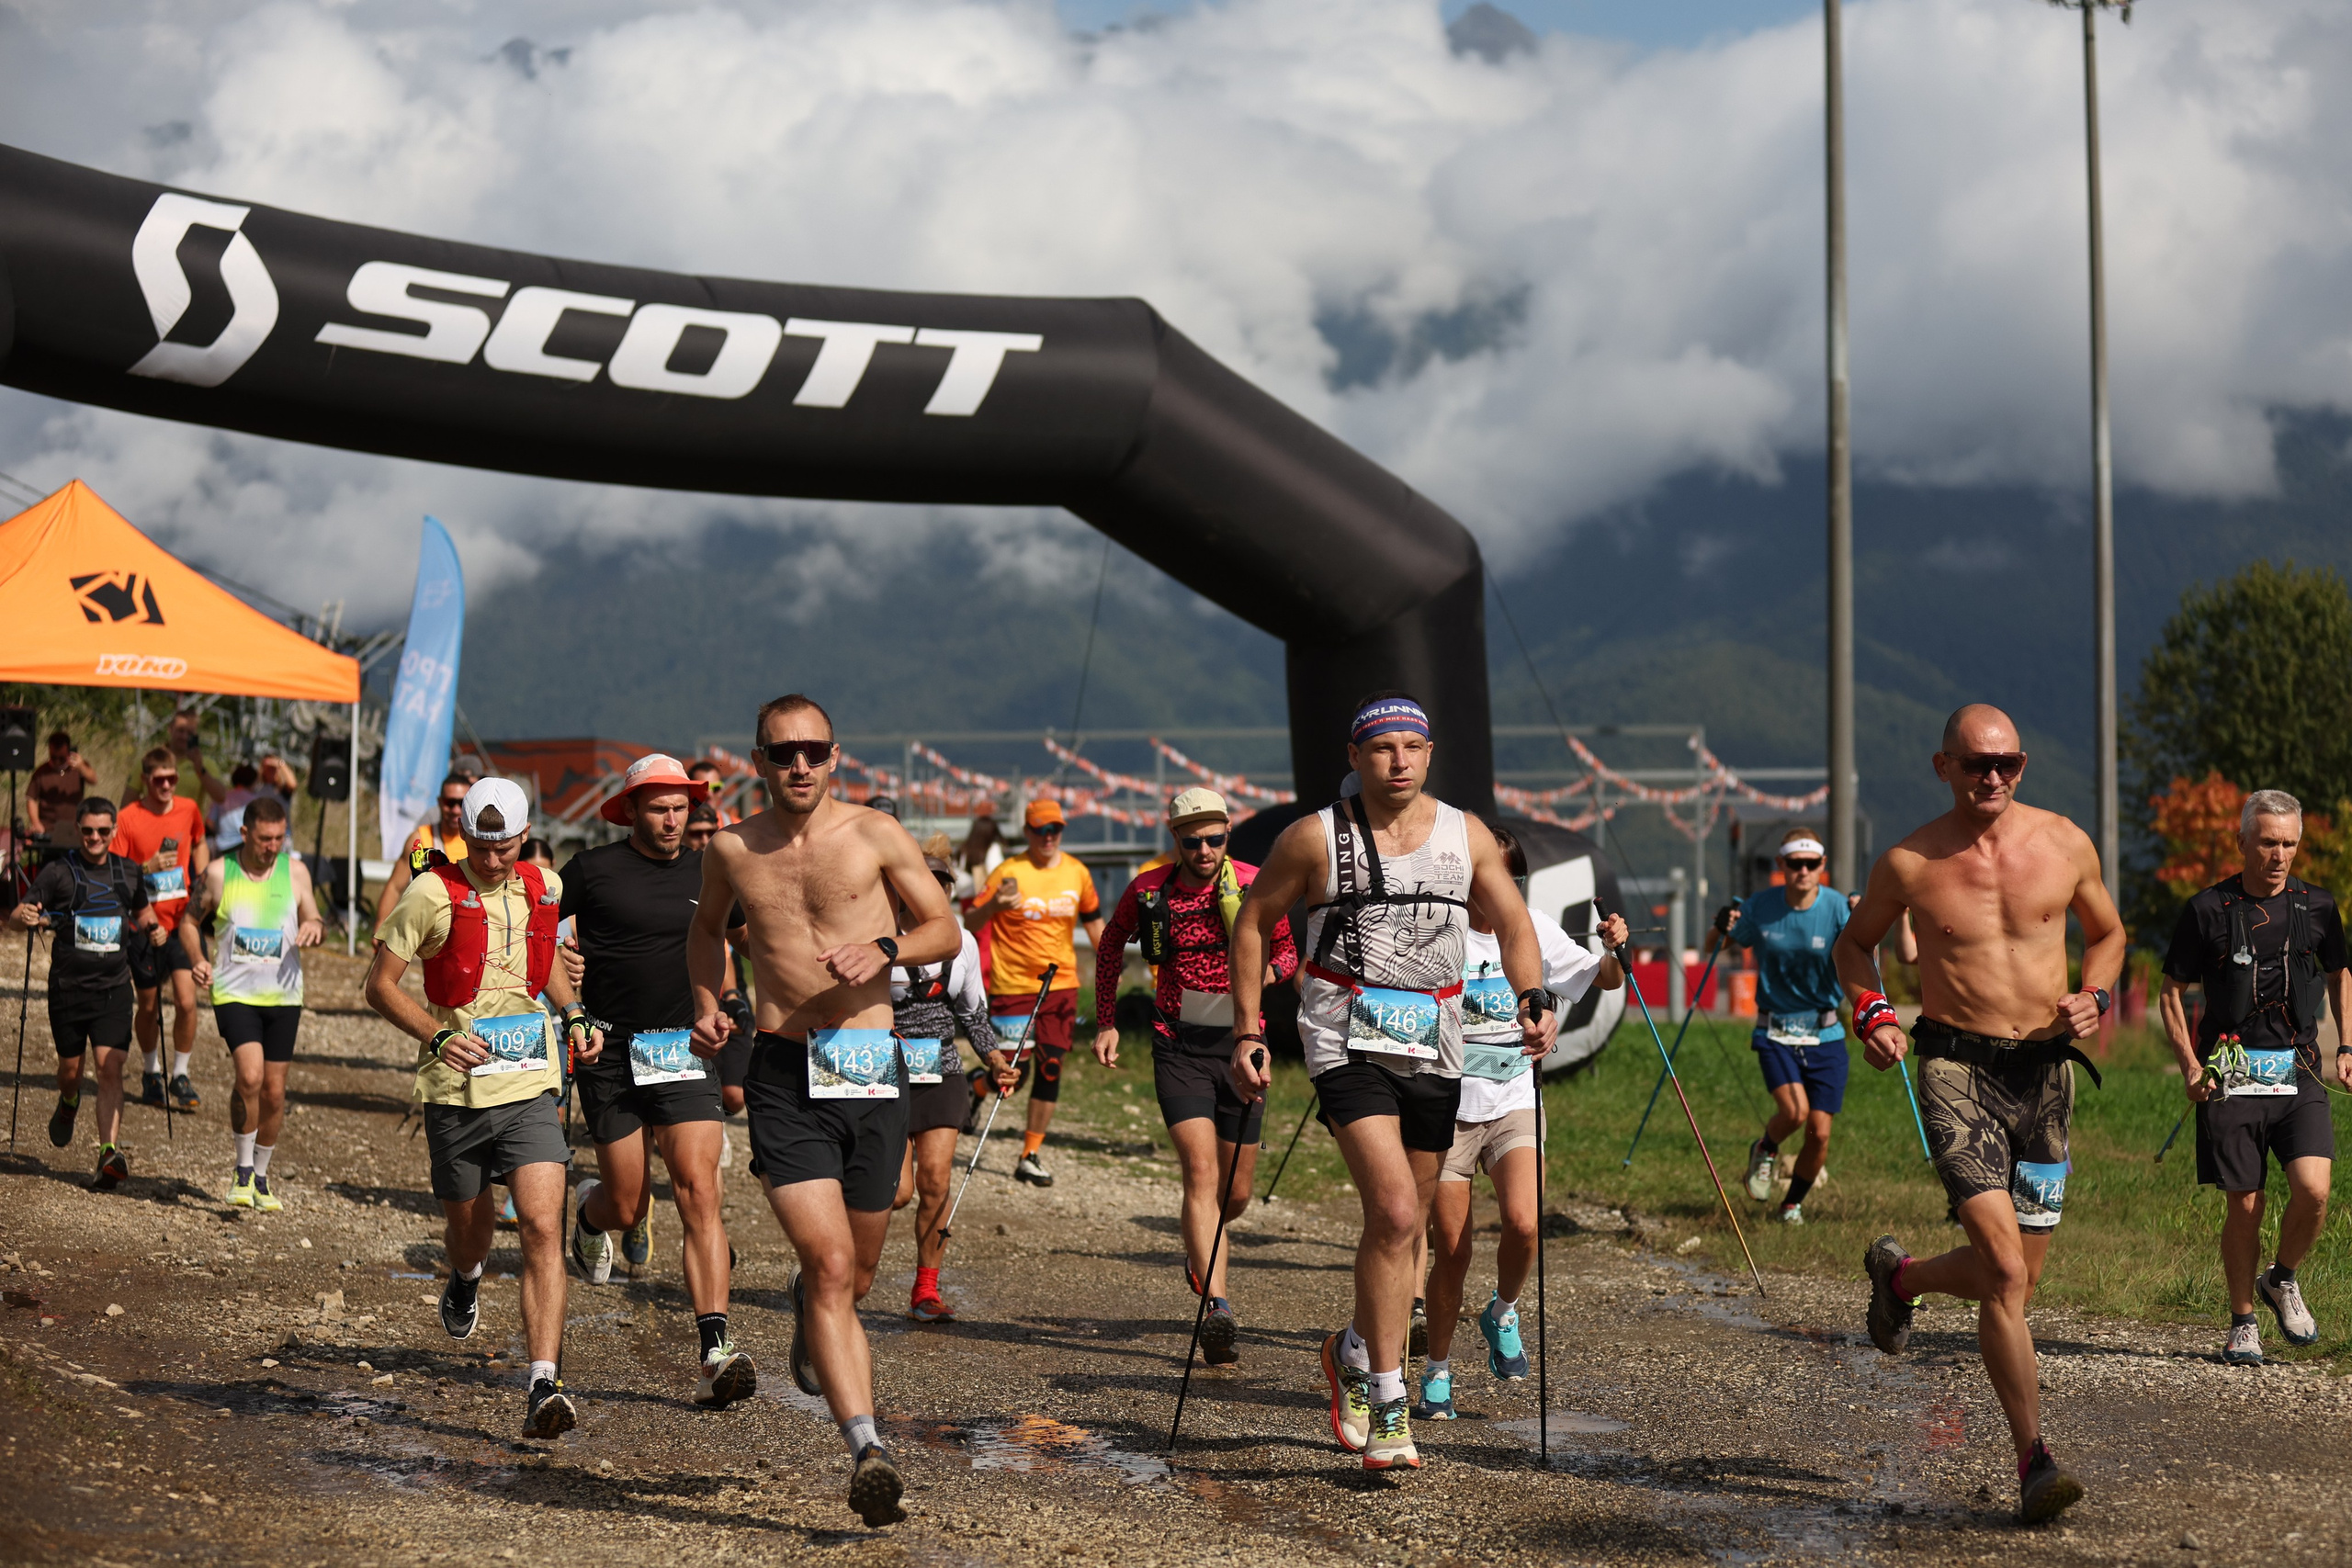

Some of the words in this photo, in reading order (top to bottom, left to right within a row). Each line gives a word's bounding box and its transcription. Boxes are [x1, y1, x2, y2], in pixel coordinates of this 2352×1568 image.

[314, 261, 1043, 416] SCOTT
[1434, 874, 1464, 882] TEAM
[86, 926, 109, 941] 119
[244, 937, 268, 952] 107
[1476, 991, 1515, 1014] 133
[1373, 1006, 1418, 1033] 146
[1000, 1024, 1023, 1039] 102
[488, 1030, 525, 1054] 109
[646, 1044, 680, 1066] 114
[830, 1046, 874, 1074] 143
[904, 1051, 925, 1067] 05
[2254, 1059, 2277, 1077] 12
